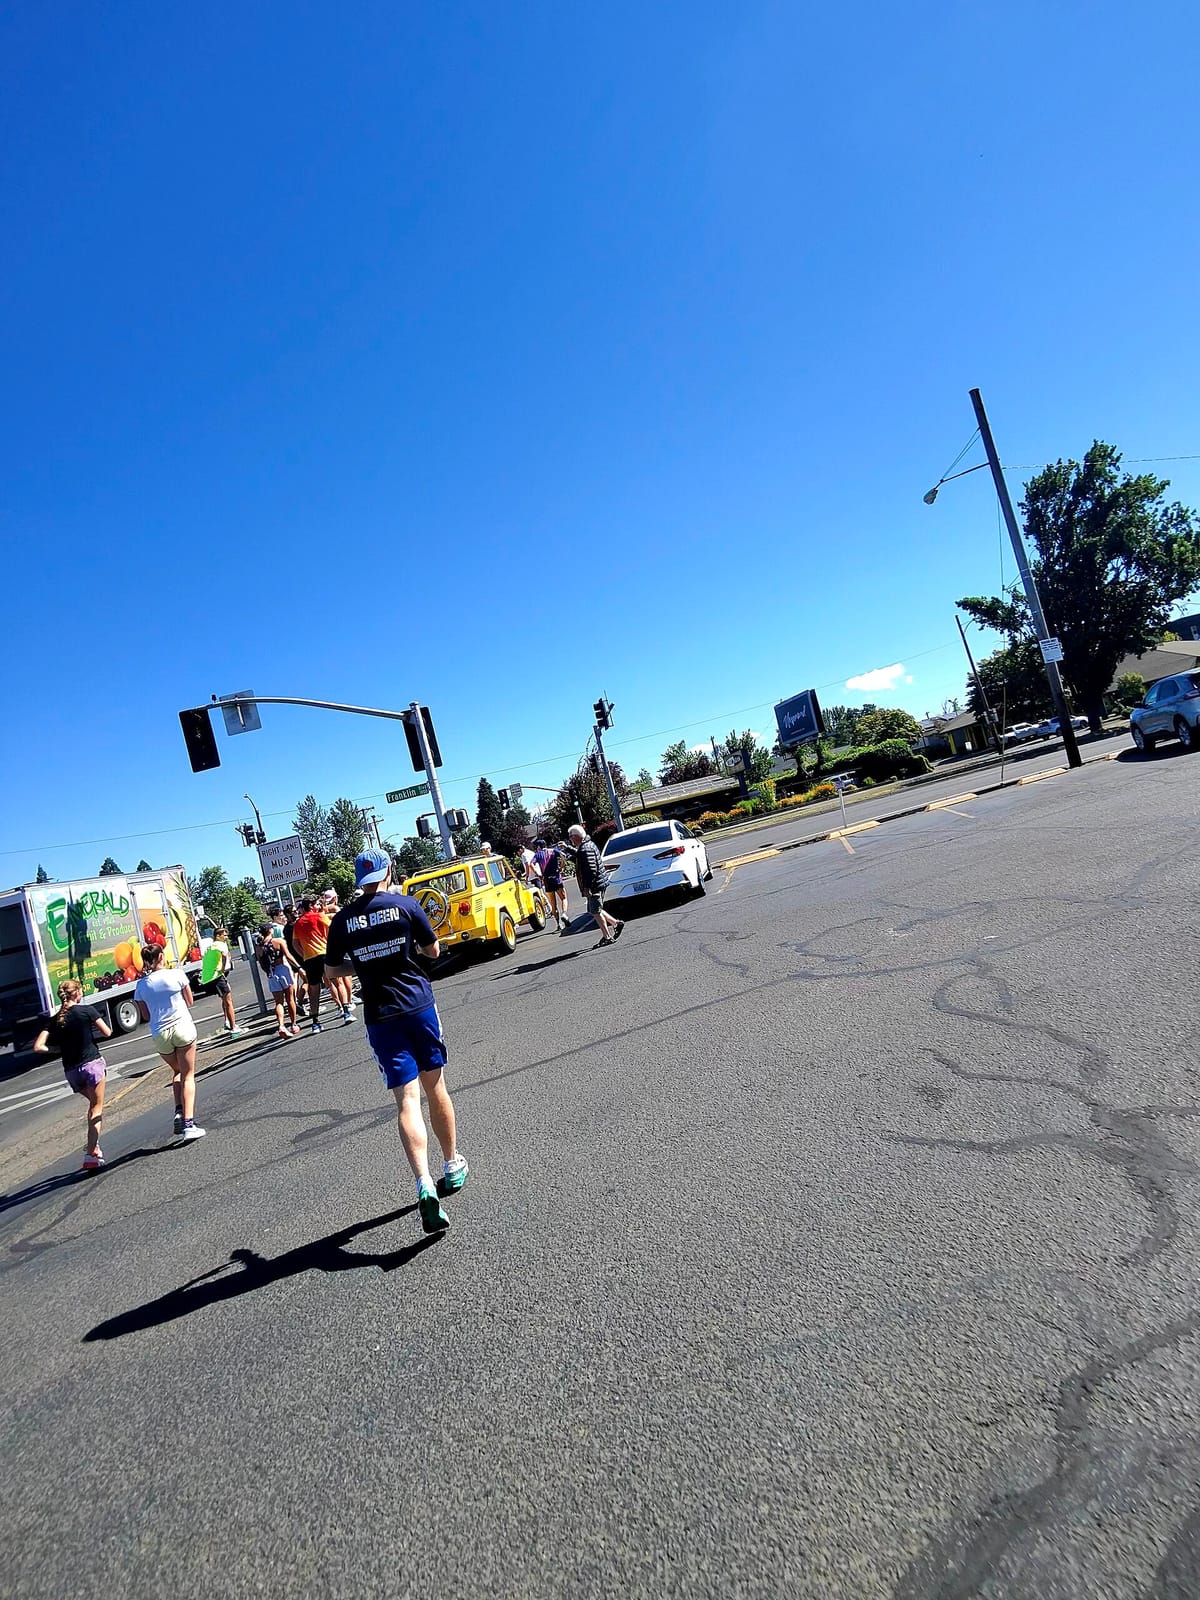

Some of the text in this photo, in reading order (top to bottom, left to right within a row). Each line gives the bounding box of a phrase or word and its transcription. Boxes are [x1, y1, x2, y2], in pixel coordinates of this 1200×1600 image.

[387, 788, 417, 802] Franklin
[261, 841, 299, 858] RIGHT LANE
[271, 855, 295, 869] MUST
[267, 867, 304, 883] TURN RIGHT
[346, 907, 400, 934] HAS BEEN
[99, 928, 106, 940] &
[106, 922, 136, 938] Produce
